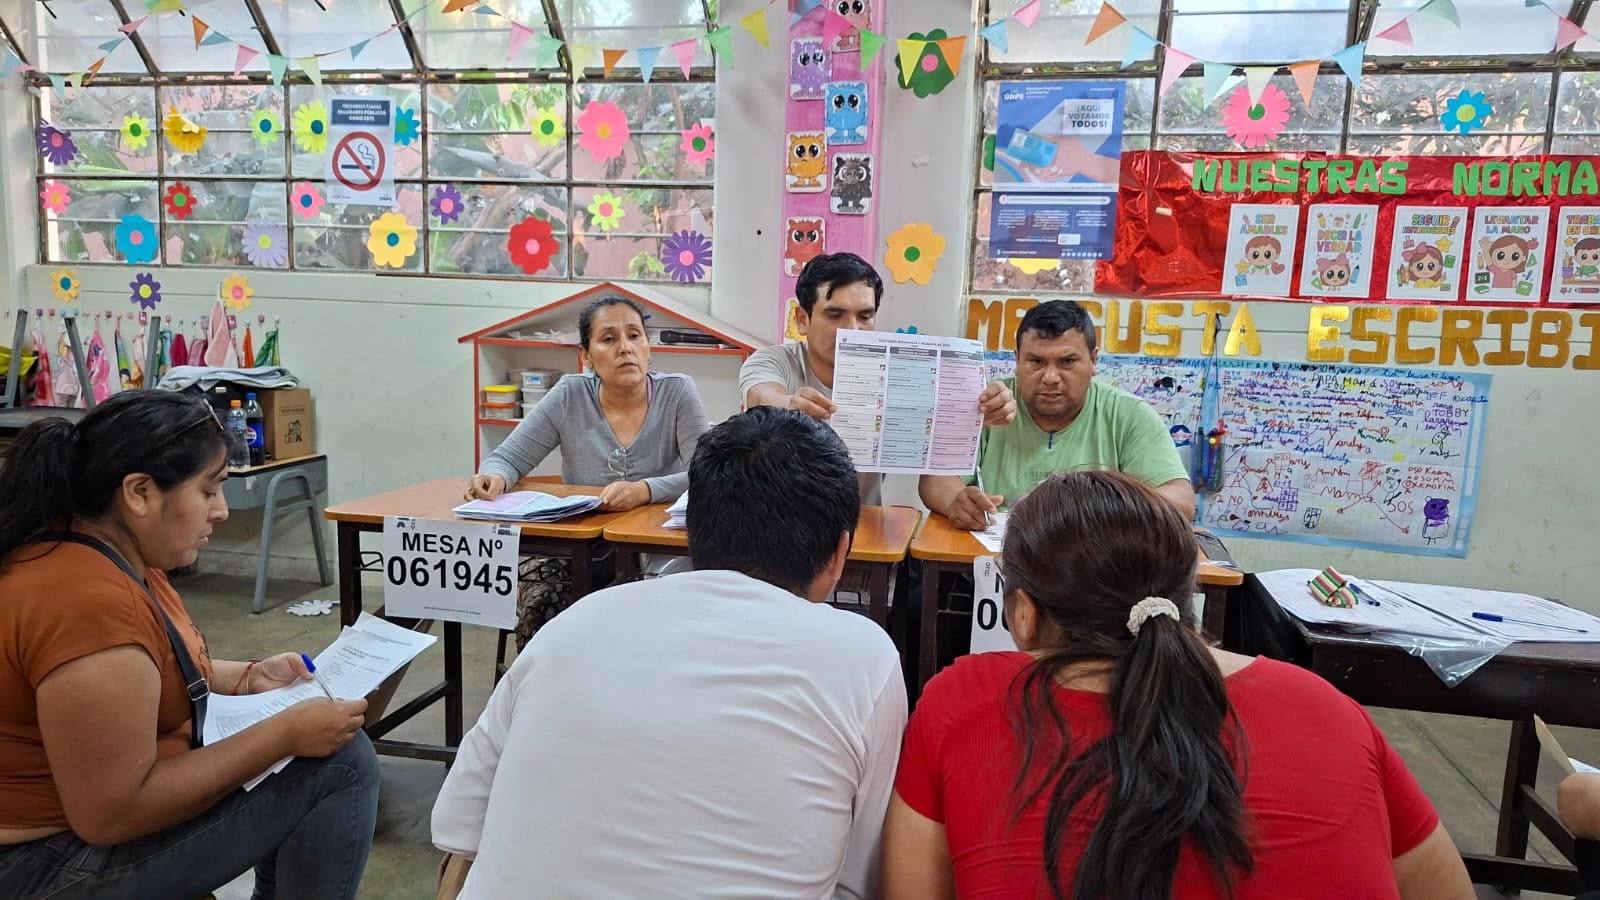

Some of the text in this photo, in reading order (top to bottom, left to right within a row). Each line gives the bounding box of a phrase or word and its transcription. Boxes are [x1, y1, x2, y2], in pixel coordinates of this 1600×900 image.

[1068, 112, 1110, 120] VOTAMOS
[1071, 120, 1108, 129] TODOS!
[1192, 159, 1409, 195] NUESTRAS
[1452, 160, 1599, 197] NORMA
[1255, 213, 1276, 225] SER
[1411, 214, 1450, 226] SEGUIR
[1484, 214, 1538, 225] LEVANTAR
[1239, 224, 1288, 235] AMABLES
[1317, 229, 1363, 241] DECIR LA
[1485, 225, 1531, 234] LA MANO
[1566, 225, 1600, 235] EN OR
[1316, 240, 1363, 253] VERDAD
[402, 532, 503, 558] MESA Nº
[387, 555, 513, 596] 061945
